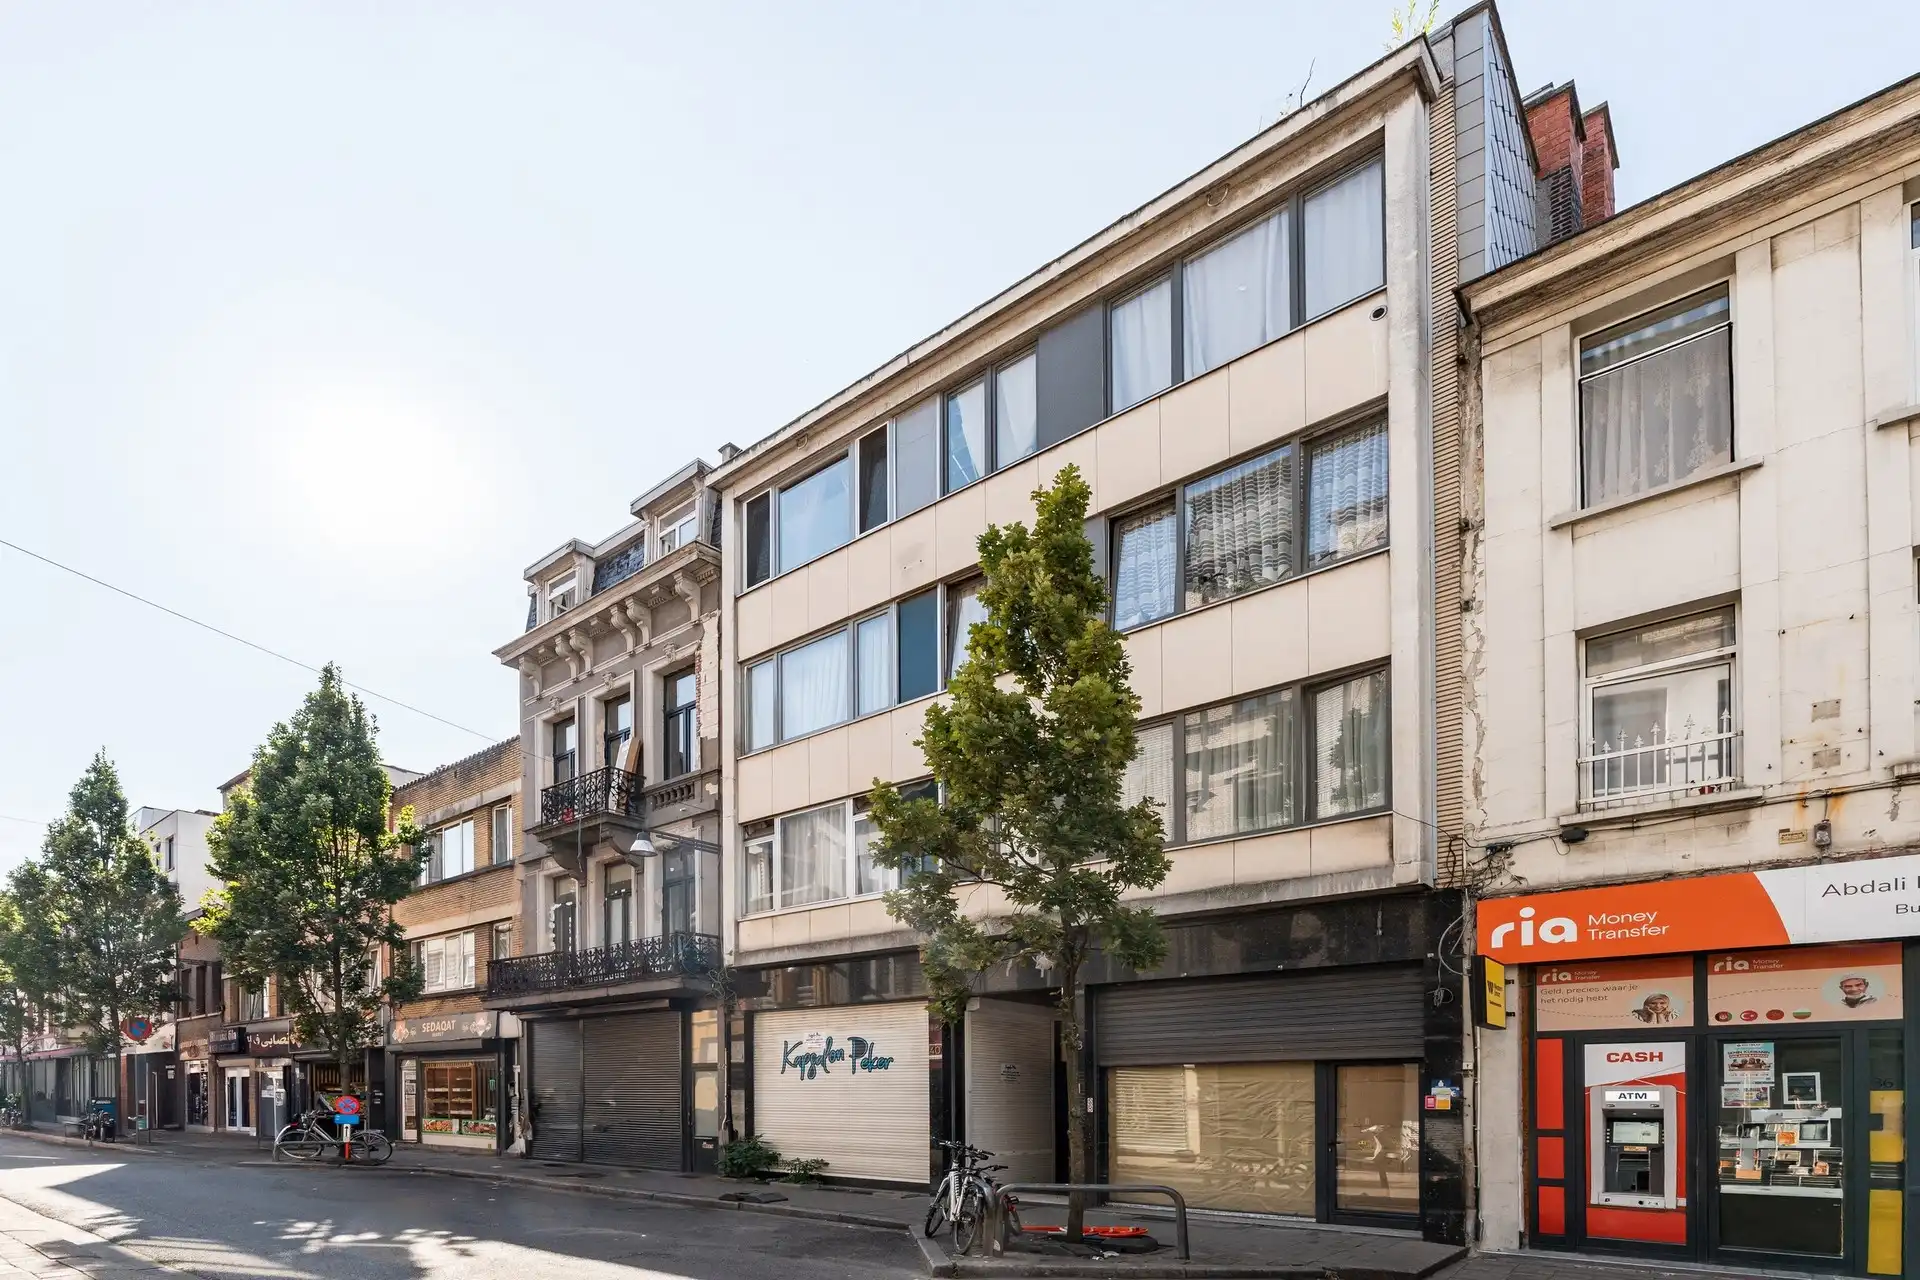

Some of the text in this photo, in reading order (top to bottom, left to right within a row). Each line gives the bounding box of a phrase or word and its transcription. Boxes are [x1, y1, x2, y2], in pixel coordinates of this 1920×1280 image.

[1821, 876, 1906, 898] Abdali
[1588, 911, 1658, 926] Money
[1490, 906, 1578, 949] ria
[1587, 924, 1669, 941] Transfer
[1713, 956, 1750, 972] ria
[1541, 968, 1572, 983] ria
[1540, 984, 1639, 995] Geld, precies waar je
[1540, 994, 1609, 1005] het nodig hebt
[421, 1020, 457, 1033] SEDAQAT
[780, 1036, 845, 1081] Kapsalon
[847, 1036, 895, 1075] Peker
[1606, 1051, 1664, 1063] CASH
[1618, 1092, 1647, 1100] ATM
